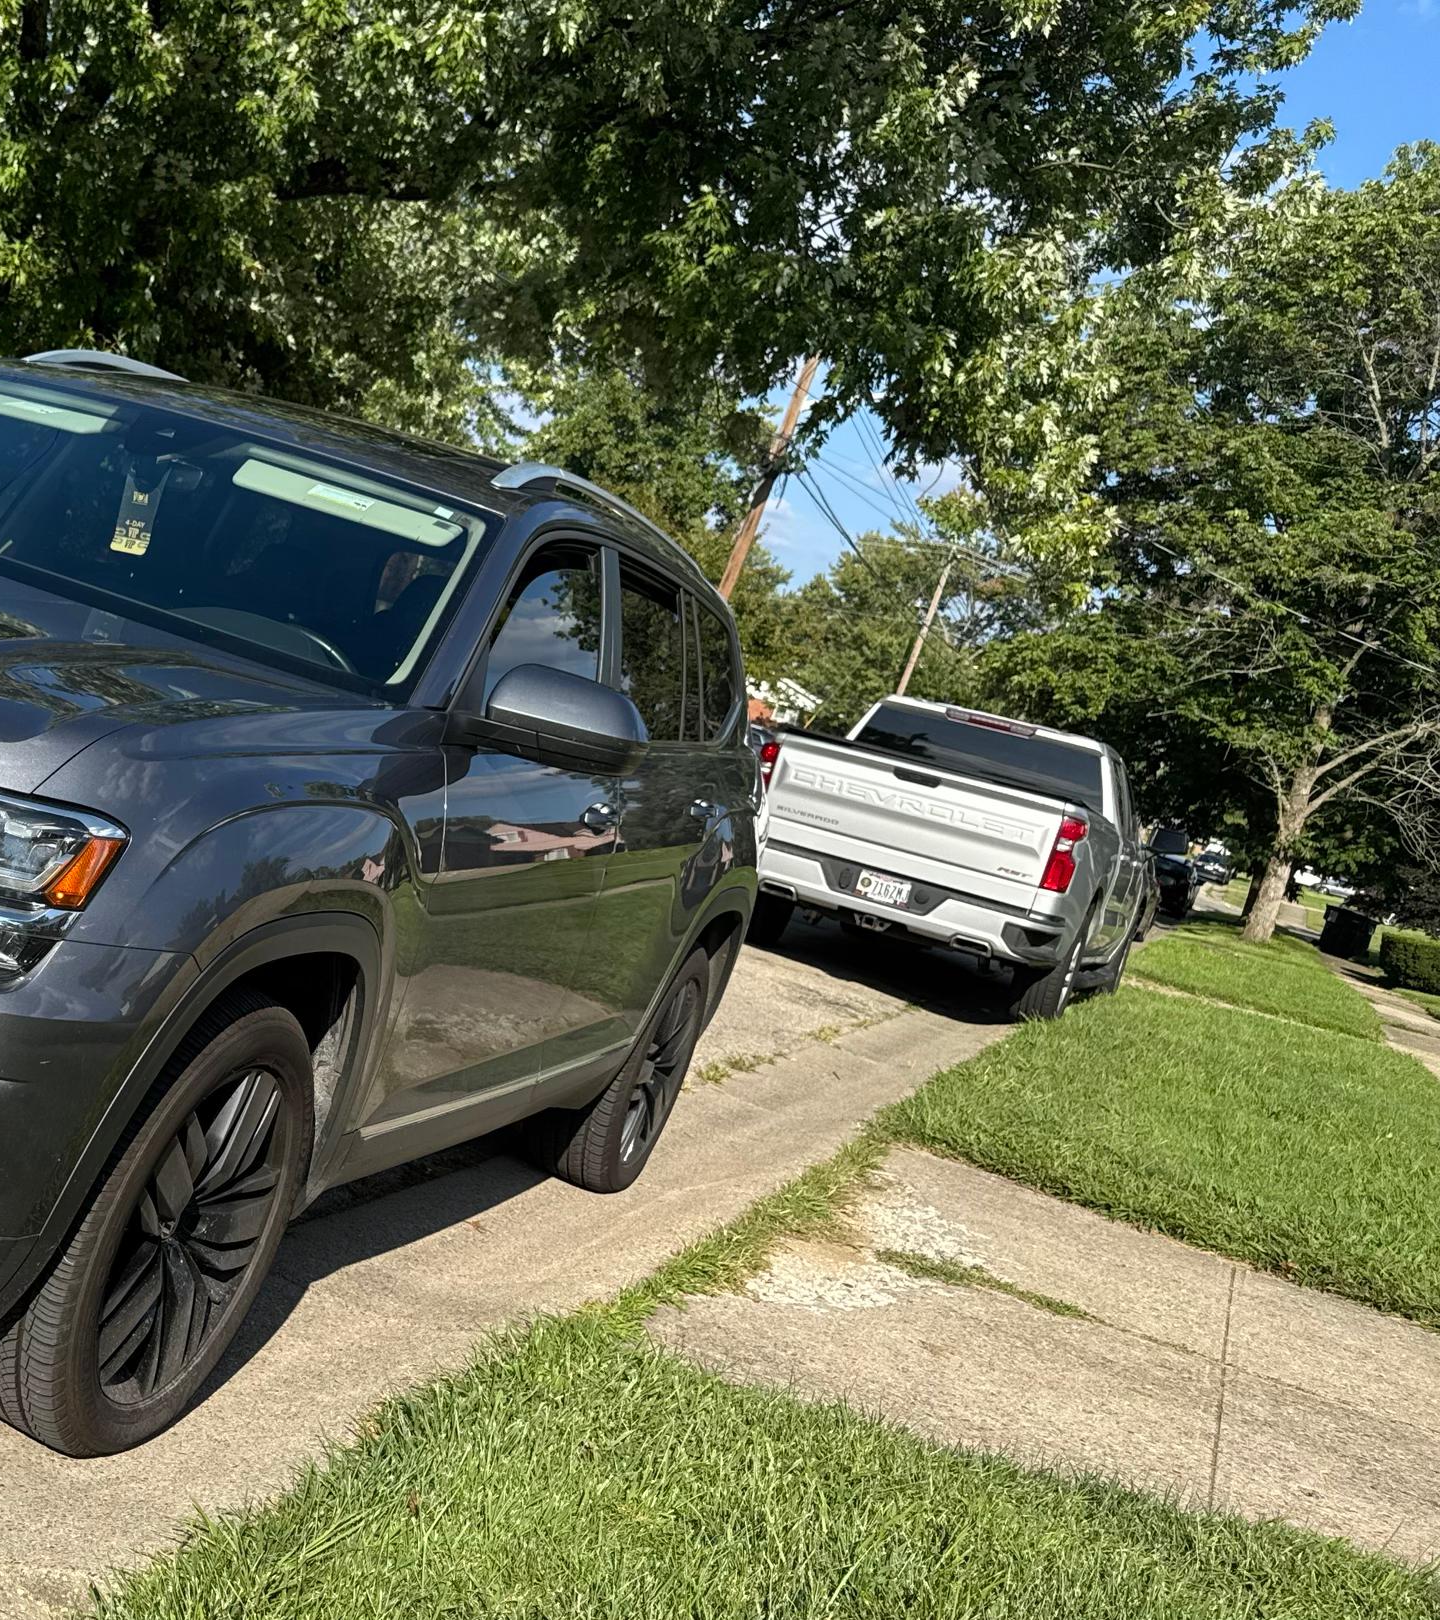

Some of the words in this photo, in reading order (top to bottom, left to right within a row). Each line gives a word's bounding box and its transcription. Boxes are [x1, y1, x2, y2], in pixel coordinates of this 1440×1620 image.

[125, 519, 146, 529] 4-DAY
[776, 804, 840, 826] SILVERADO
[791, 767, 1037, 844] CHEVROLET
